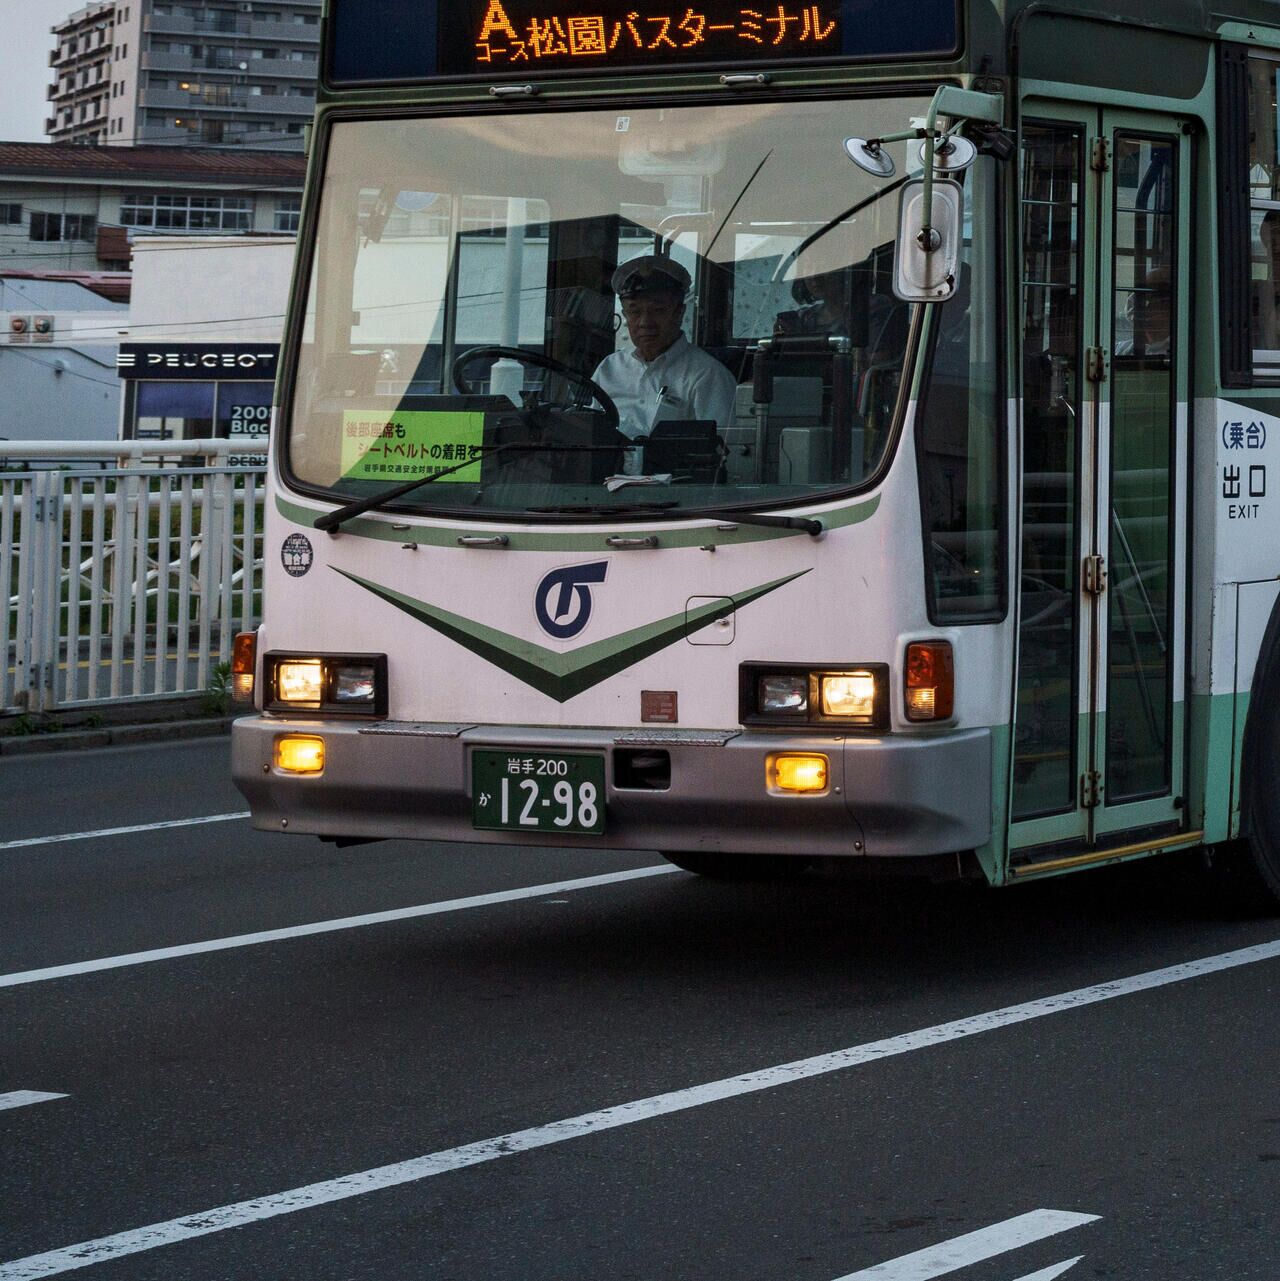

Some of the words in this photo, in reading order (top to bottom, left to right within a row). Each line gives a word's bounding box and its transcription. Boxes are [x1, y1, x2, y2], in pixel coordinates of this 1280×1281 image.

[479, 0, 518, 40] A
[526, 5, 835, 58] 松園バスターミナル
[475, 41, 528, 62] コース
[147, 353, 274, 367] PEUGEOT
[232, 406, 270, 419] 200
[358, 442, 478, 460] シートベルトの着用を
[1223, 464, 1266, 498] 出口
[1228, 504, 1260, 519] EXIT
[508, 758, 534, 775] 岩手
[536, 759, 567, 776] 200
[501, 777, 598, 828] 12-98
